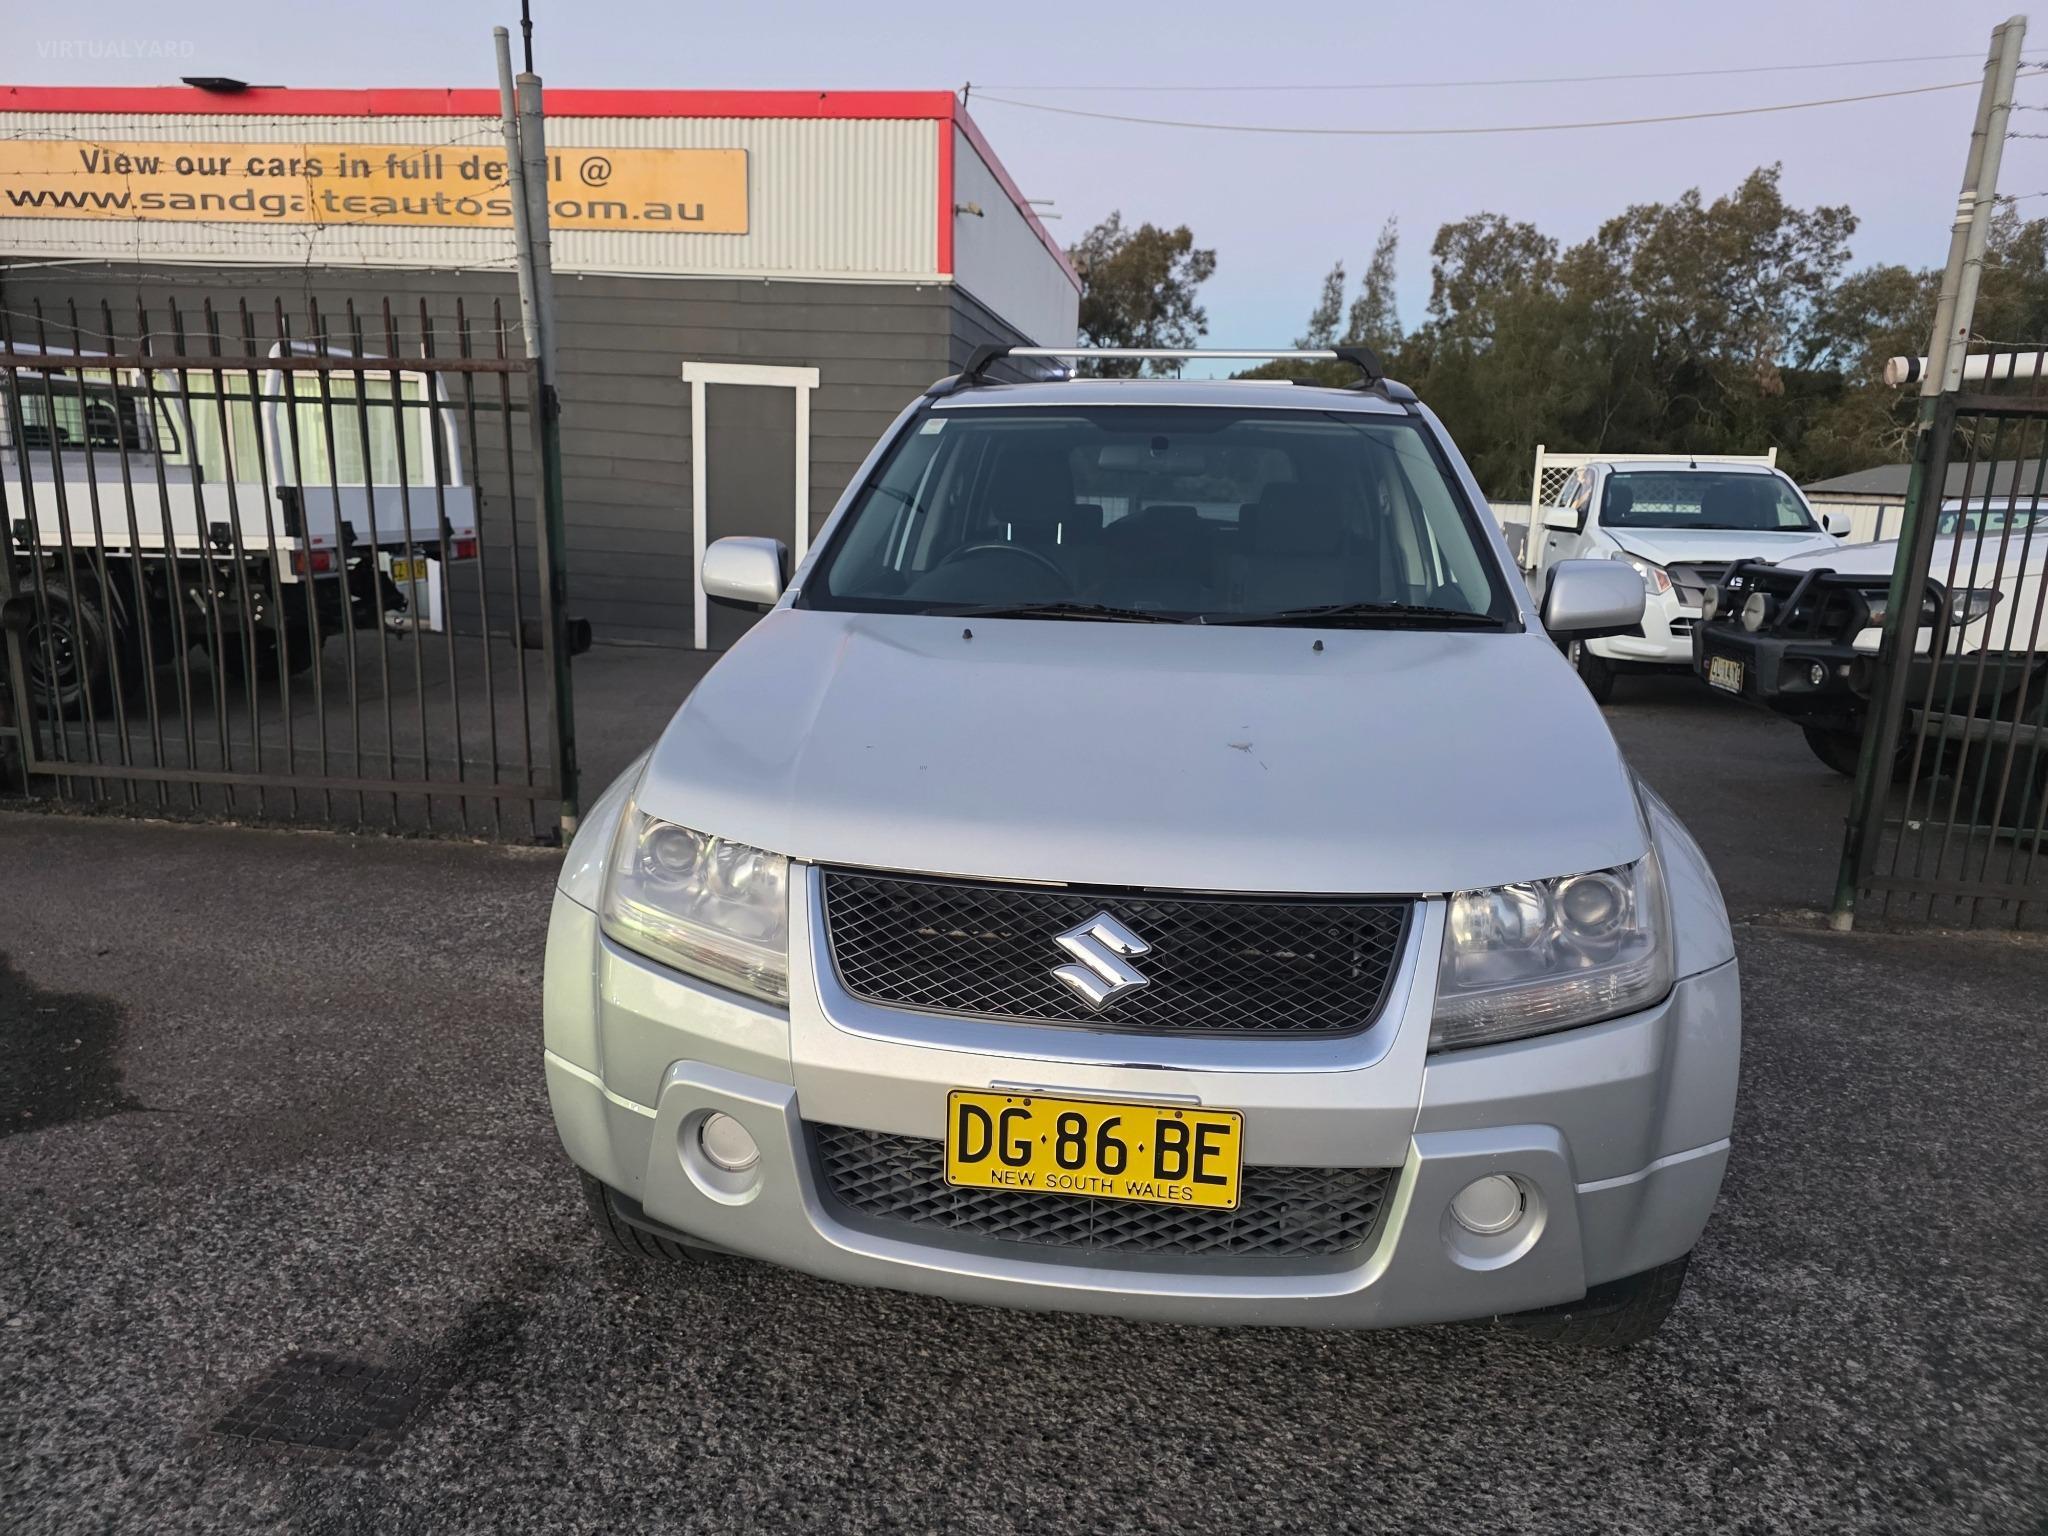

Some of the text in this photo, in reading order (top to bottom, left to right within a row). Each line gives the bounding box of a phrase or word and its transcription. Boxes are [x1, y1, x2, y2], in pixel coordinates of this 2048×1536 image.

[79, 149, 612, 187] View our cars in full deil @
[991, 1169, 1193, 1201] NEW SOUTH WALES
